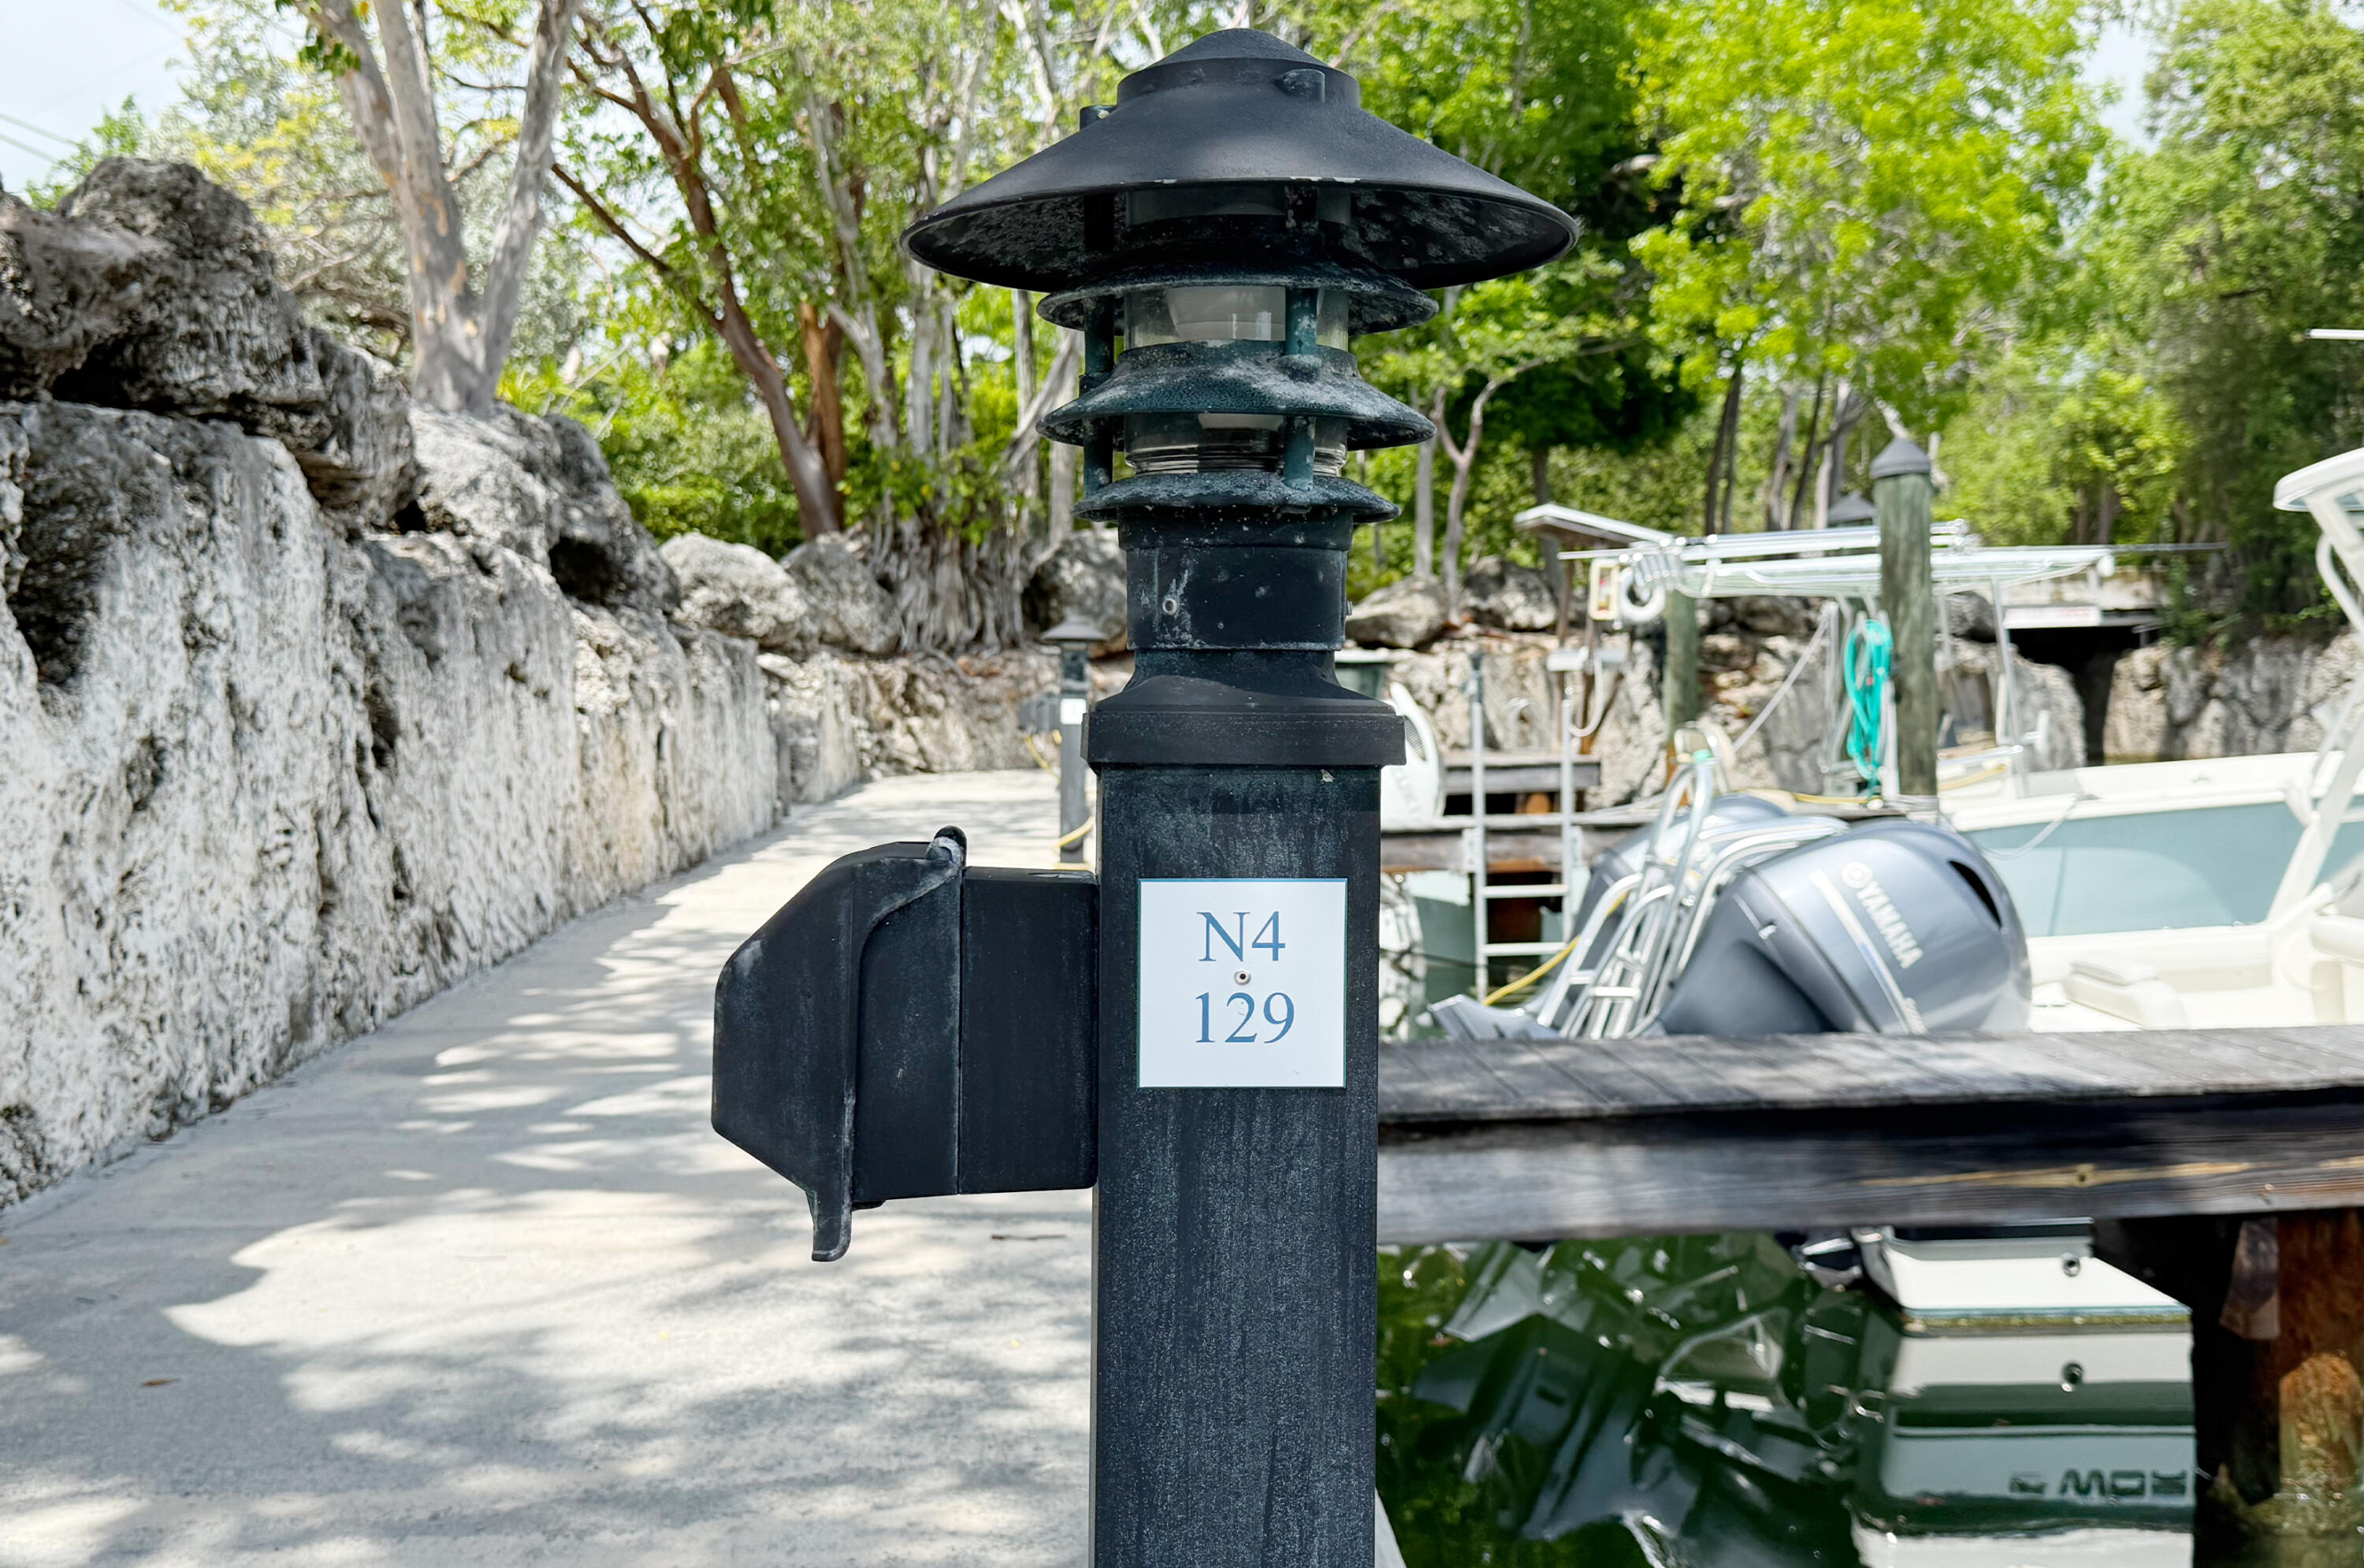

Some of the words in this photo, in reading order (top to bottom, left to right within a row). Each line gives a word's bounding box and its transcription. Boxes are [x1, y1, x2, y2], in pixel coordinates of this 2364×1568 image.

[1195, 911, 1286, 962] N4
[1856, 880, 1924, 970] YAMAHA
[1195, 991, 1295, 1044] 129
